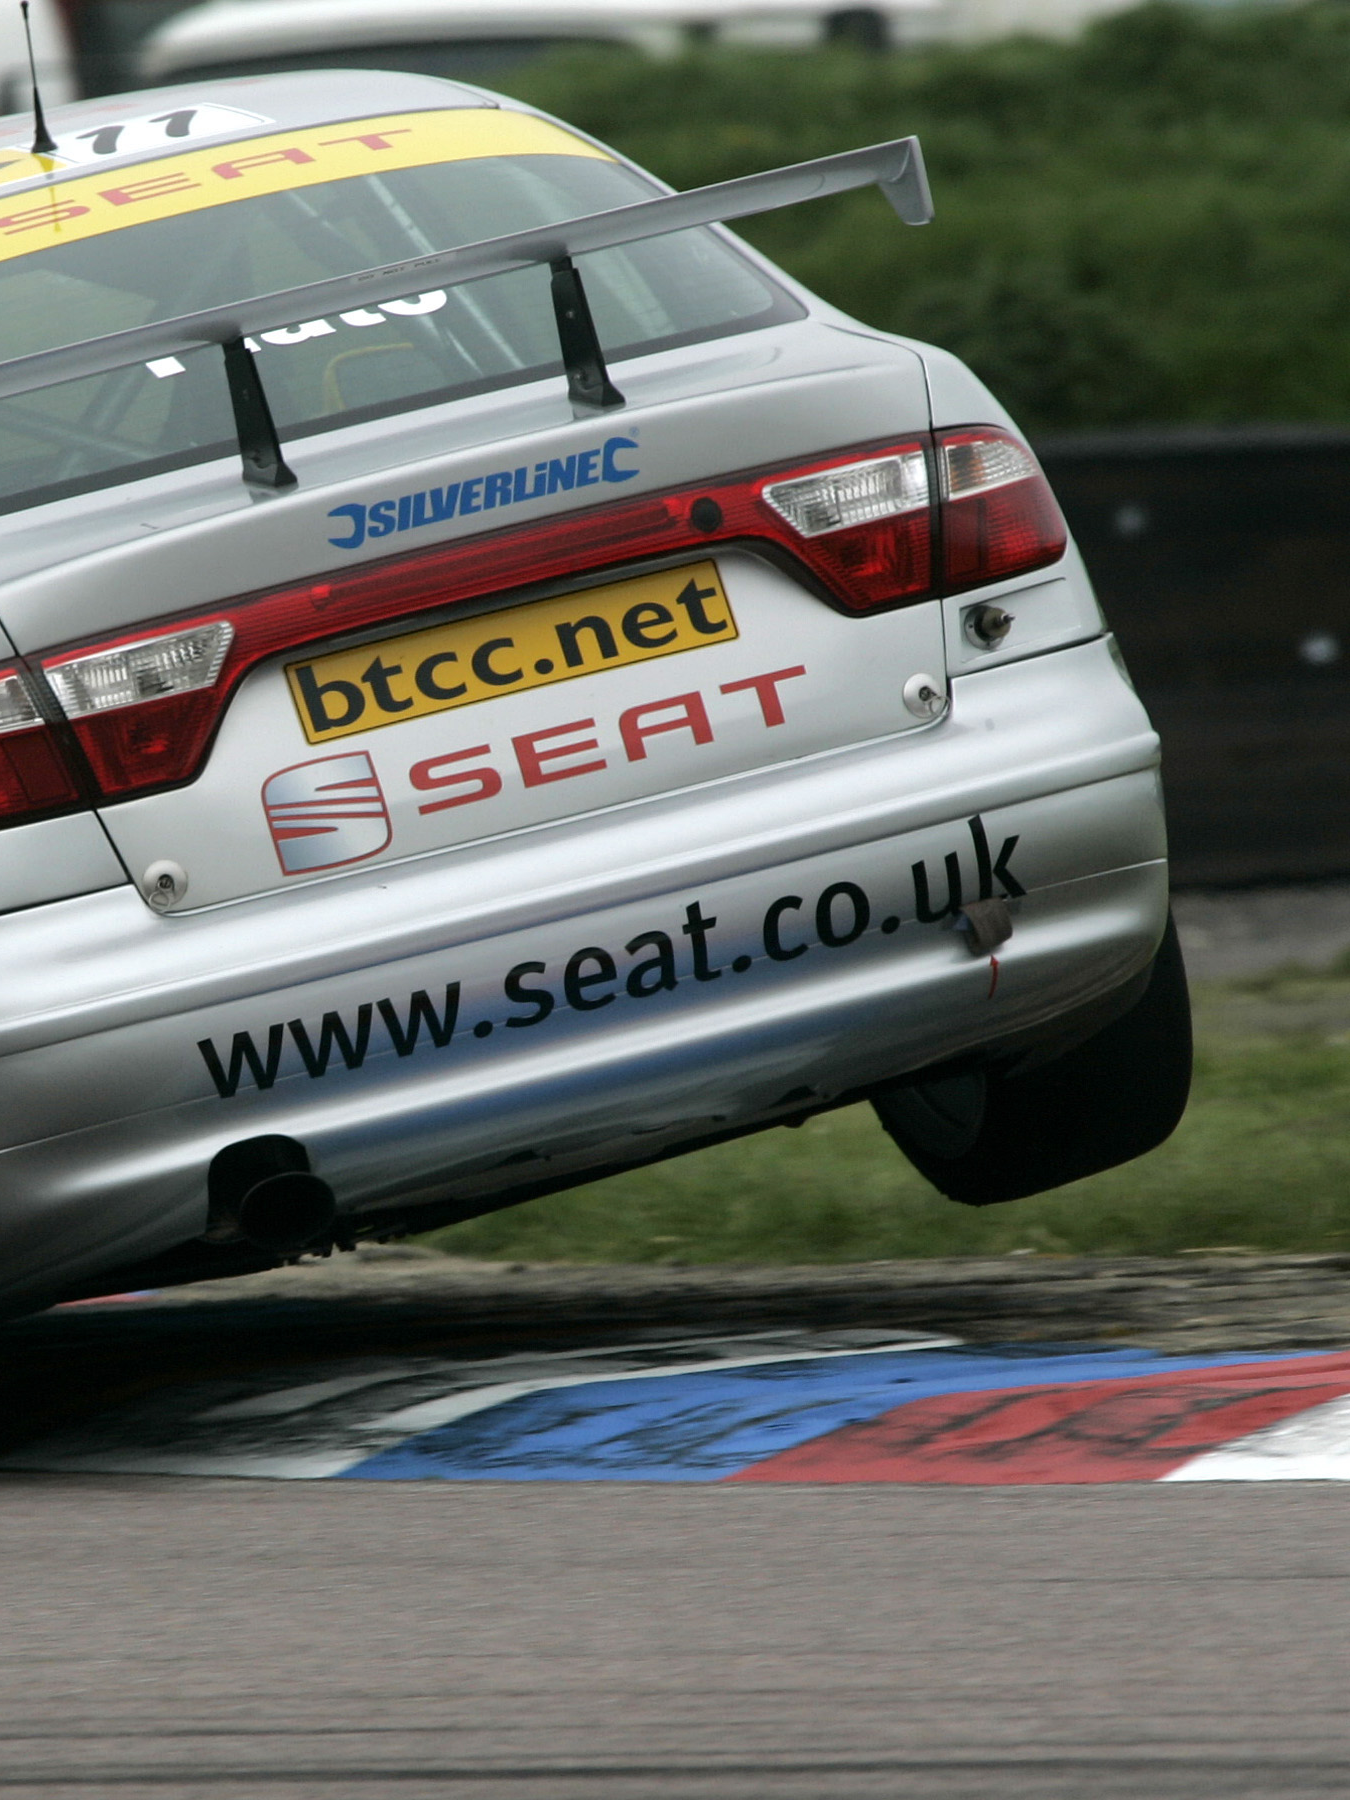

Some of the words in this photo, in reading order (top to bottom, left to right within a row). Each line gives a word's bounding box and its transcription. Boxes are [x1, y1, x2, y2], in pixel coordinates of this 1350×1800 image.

[75, 109, 198, 155] 11
[296, 577, 729, 736] btcc.net
[408, 664, 807, 816] SEAT
[196, 813, 1030, 1100] www.seat.co.uk
